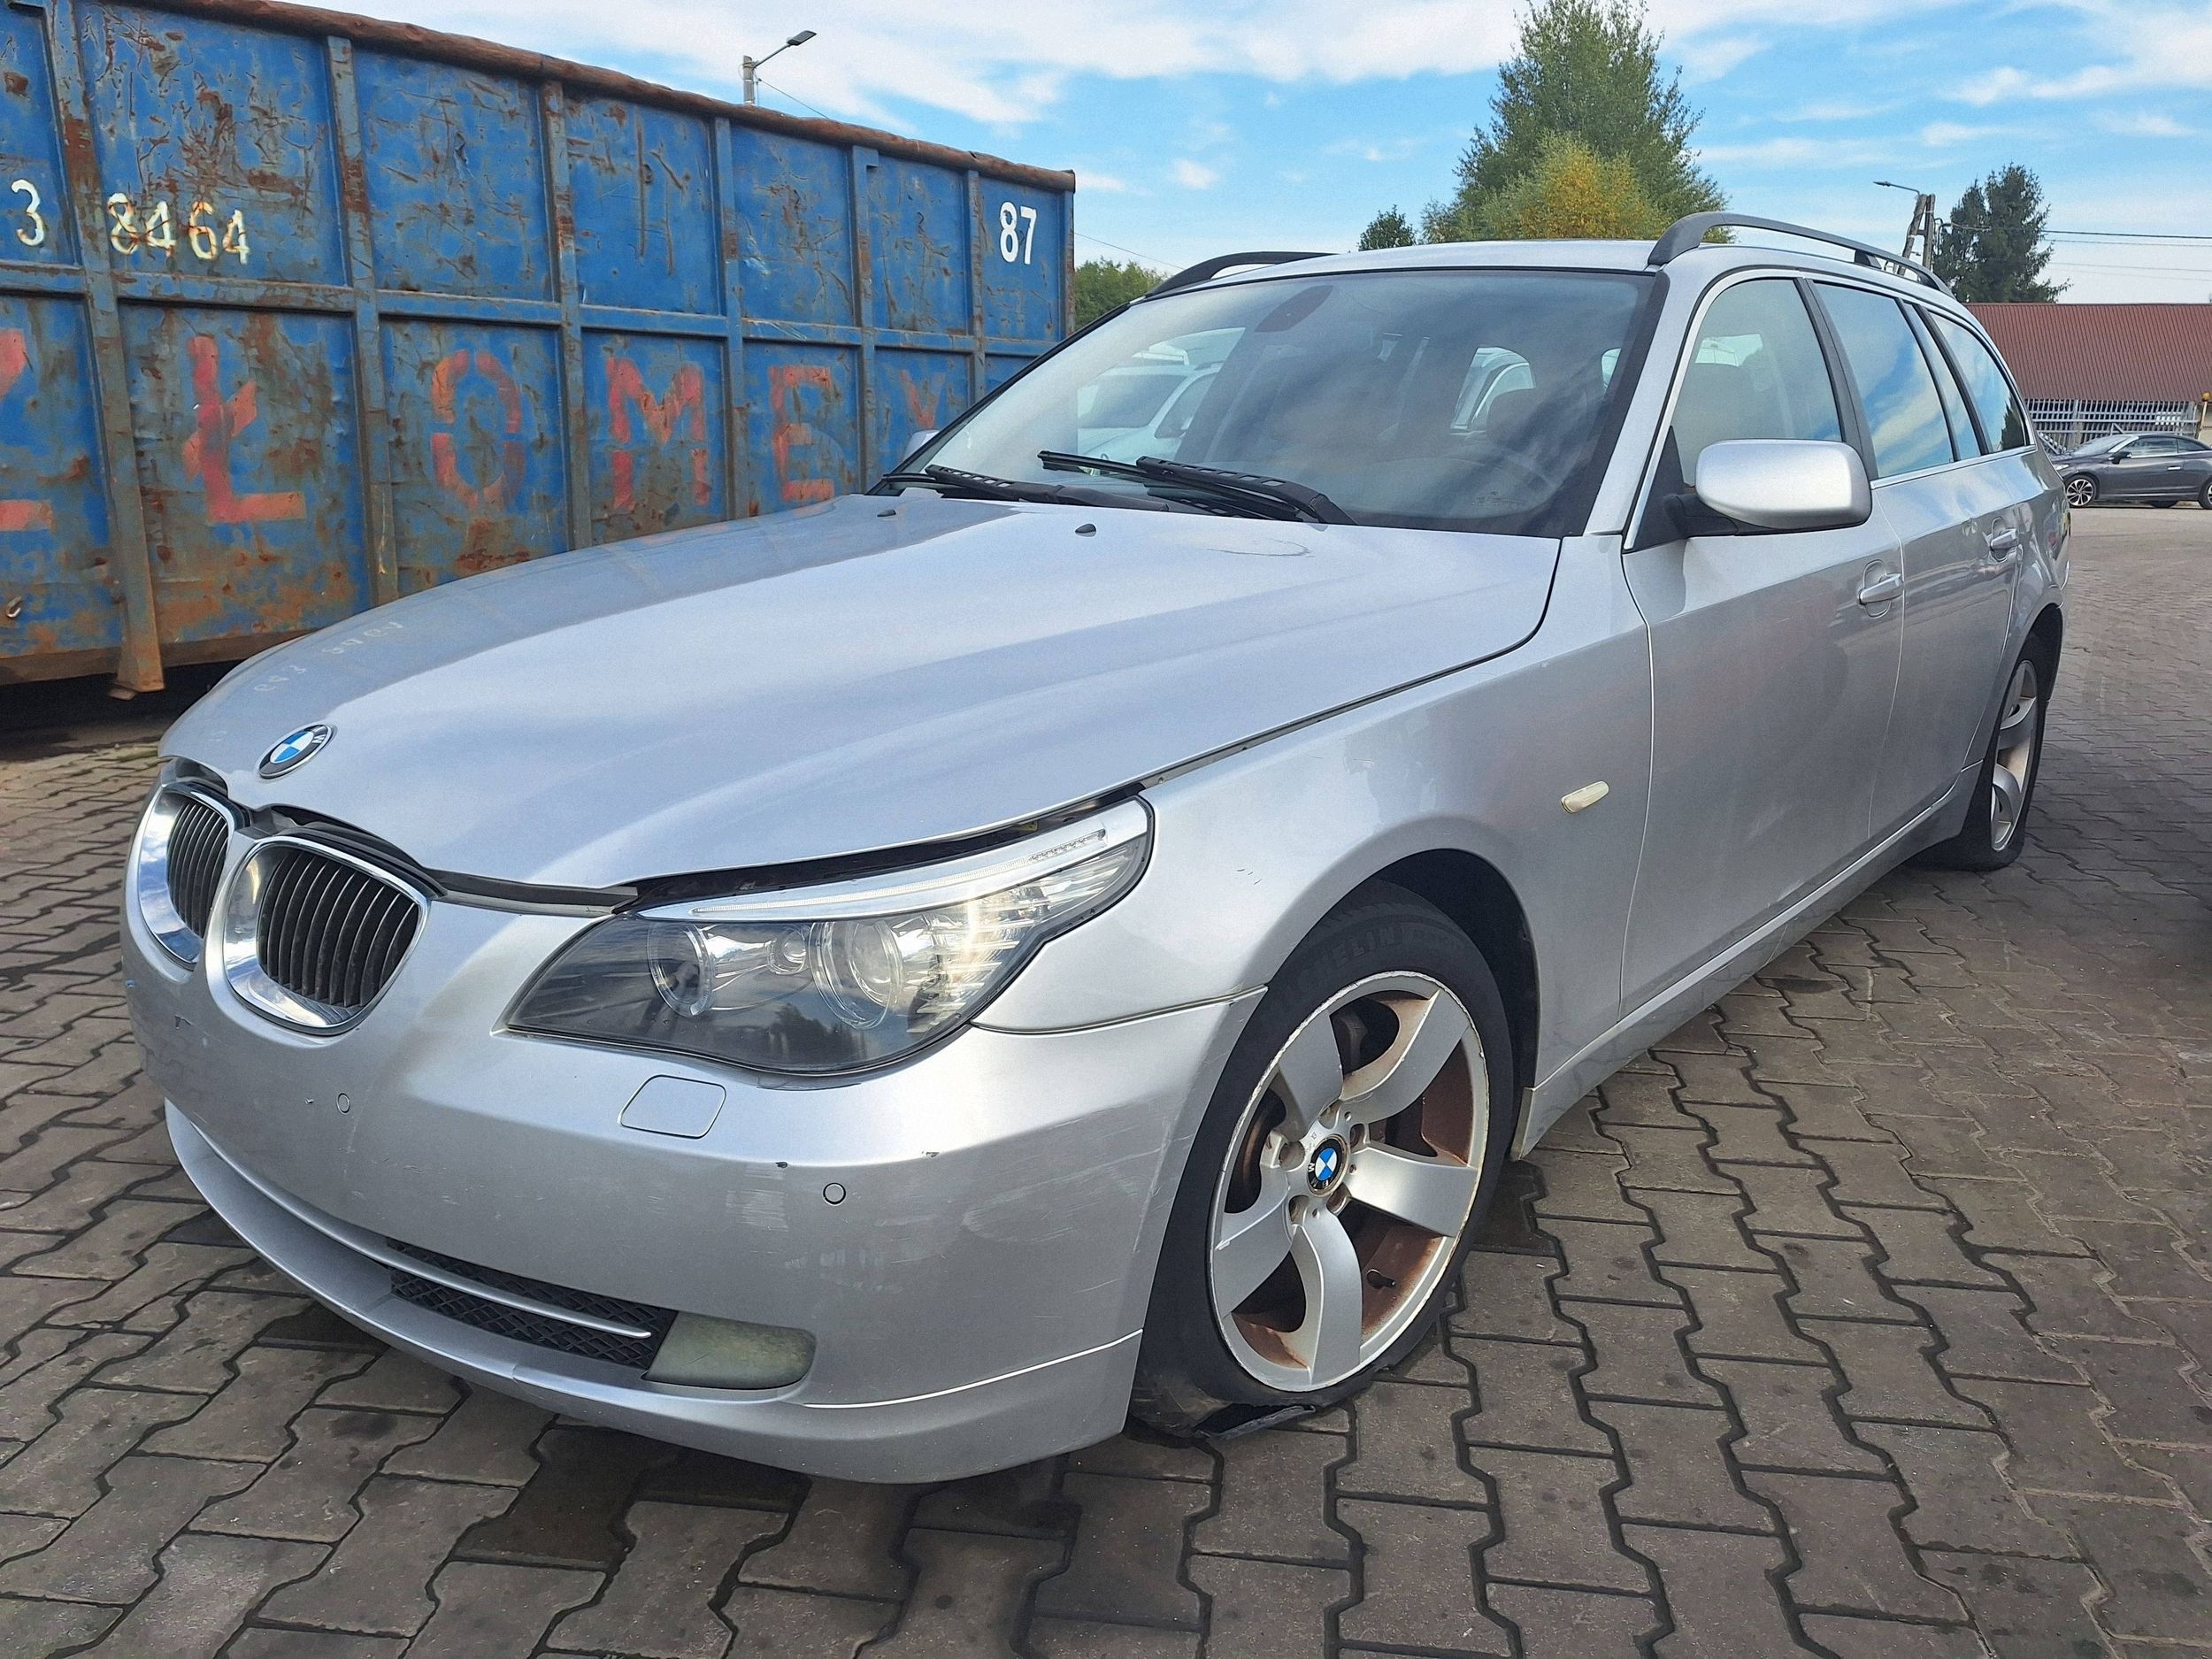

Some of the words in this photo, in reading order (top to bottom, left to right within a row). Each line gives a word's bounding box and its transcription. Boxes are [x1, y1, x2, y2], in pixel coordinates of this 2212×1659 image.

[11, 179, 44, 247] 3
[107, 192, 250, 265] 8464
[1000, 202, 1037, 265] 87
